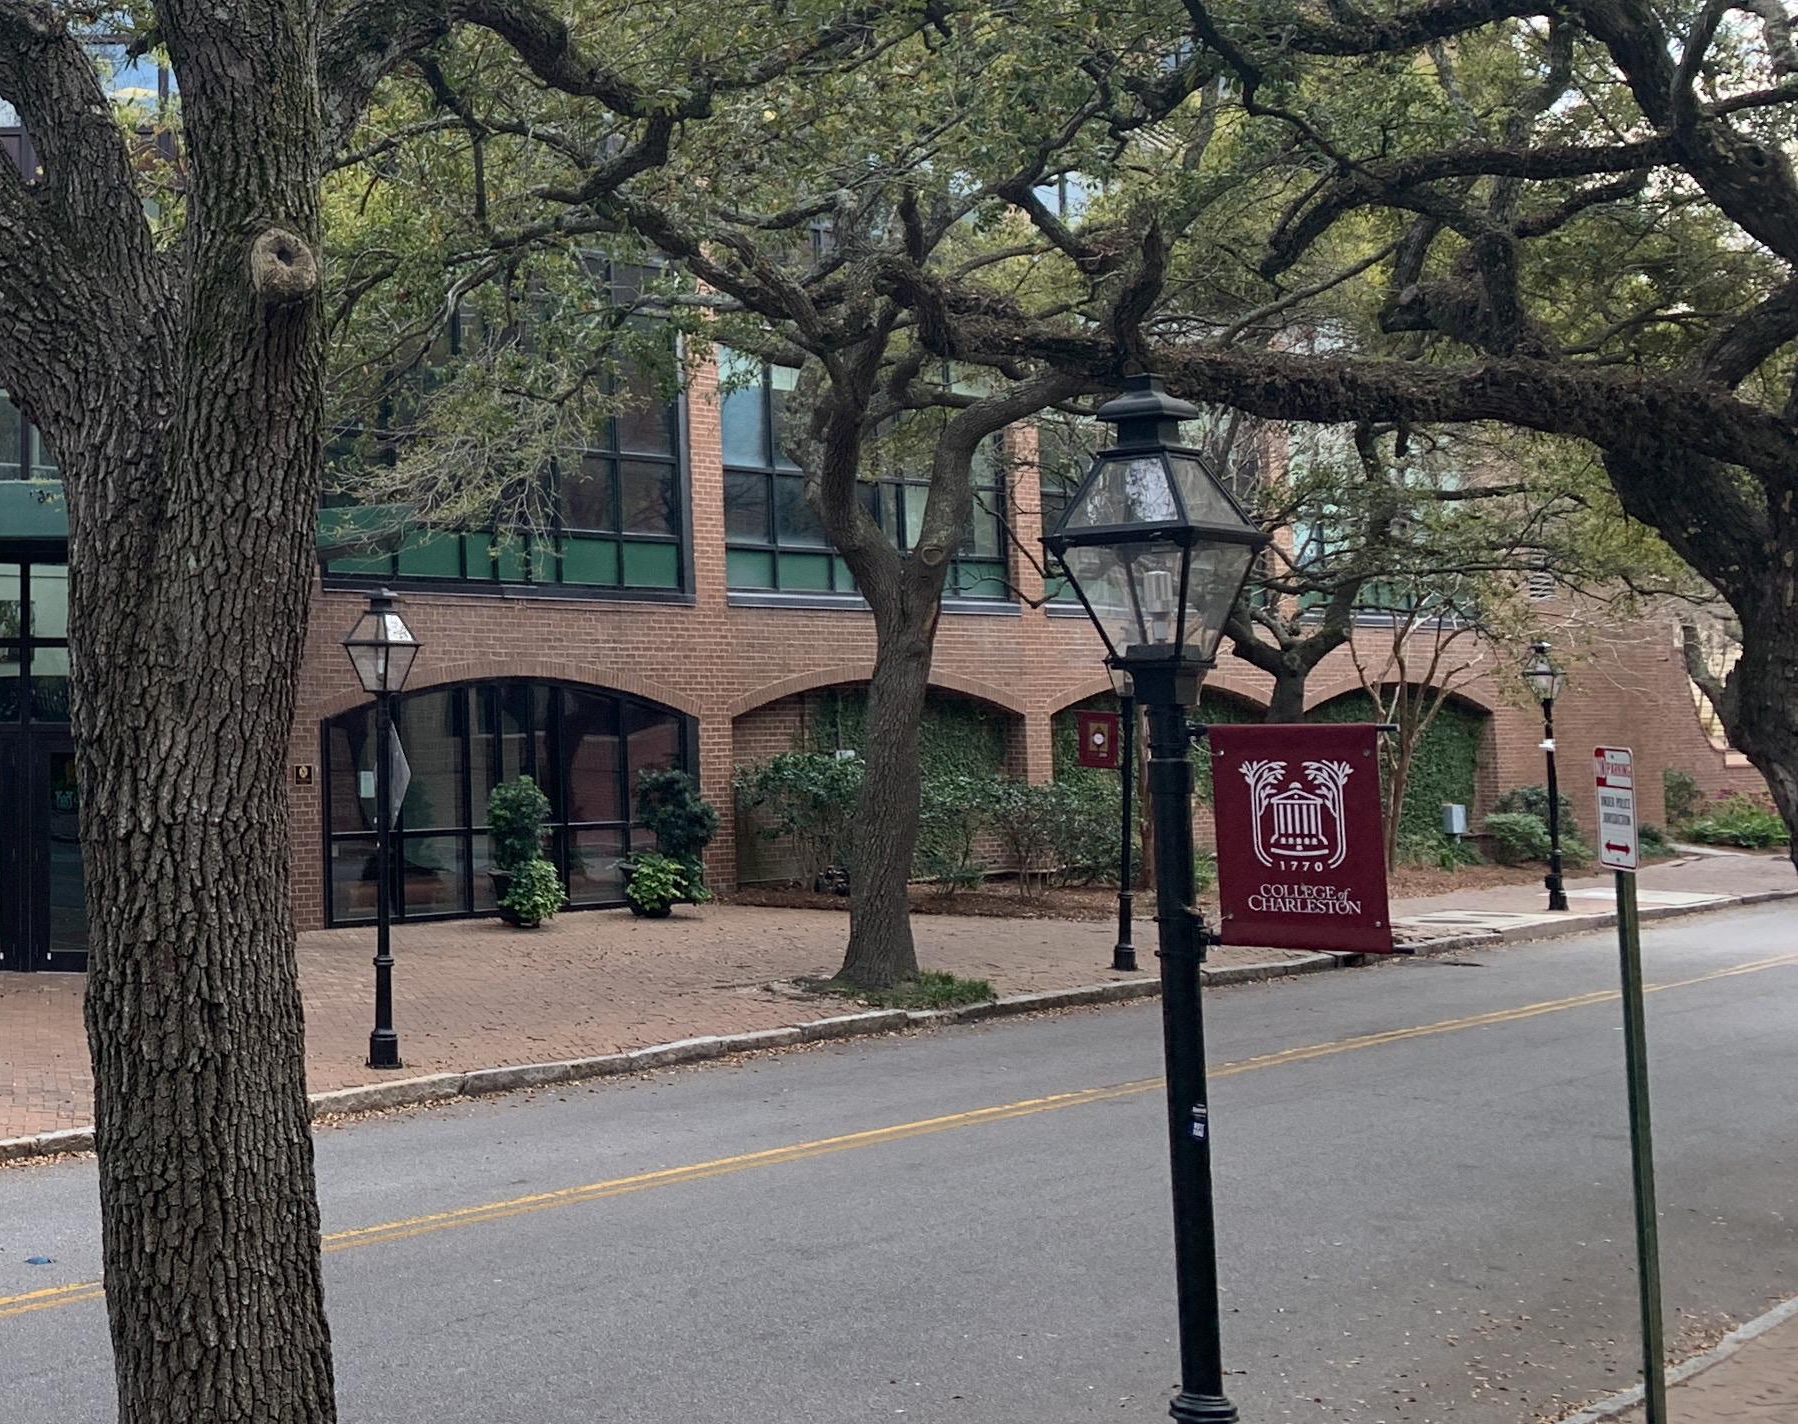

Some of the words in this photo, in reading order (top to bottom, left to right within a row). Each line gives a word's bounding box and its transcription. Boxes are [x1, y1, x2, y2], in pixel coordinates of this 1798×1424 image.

[1280, 861, 1323, 871] 1770
[1260, 883, 1336, 899] COLLEGE
[1337, 887, 1351, 905] of
[1248, 895, 1361, 914] CHARLESTON
